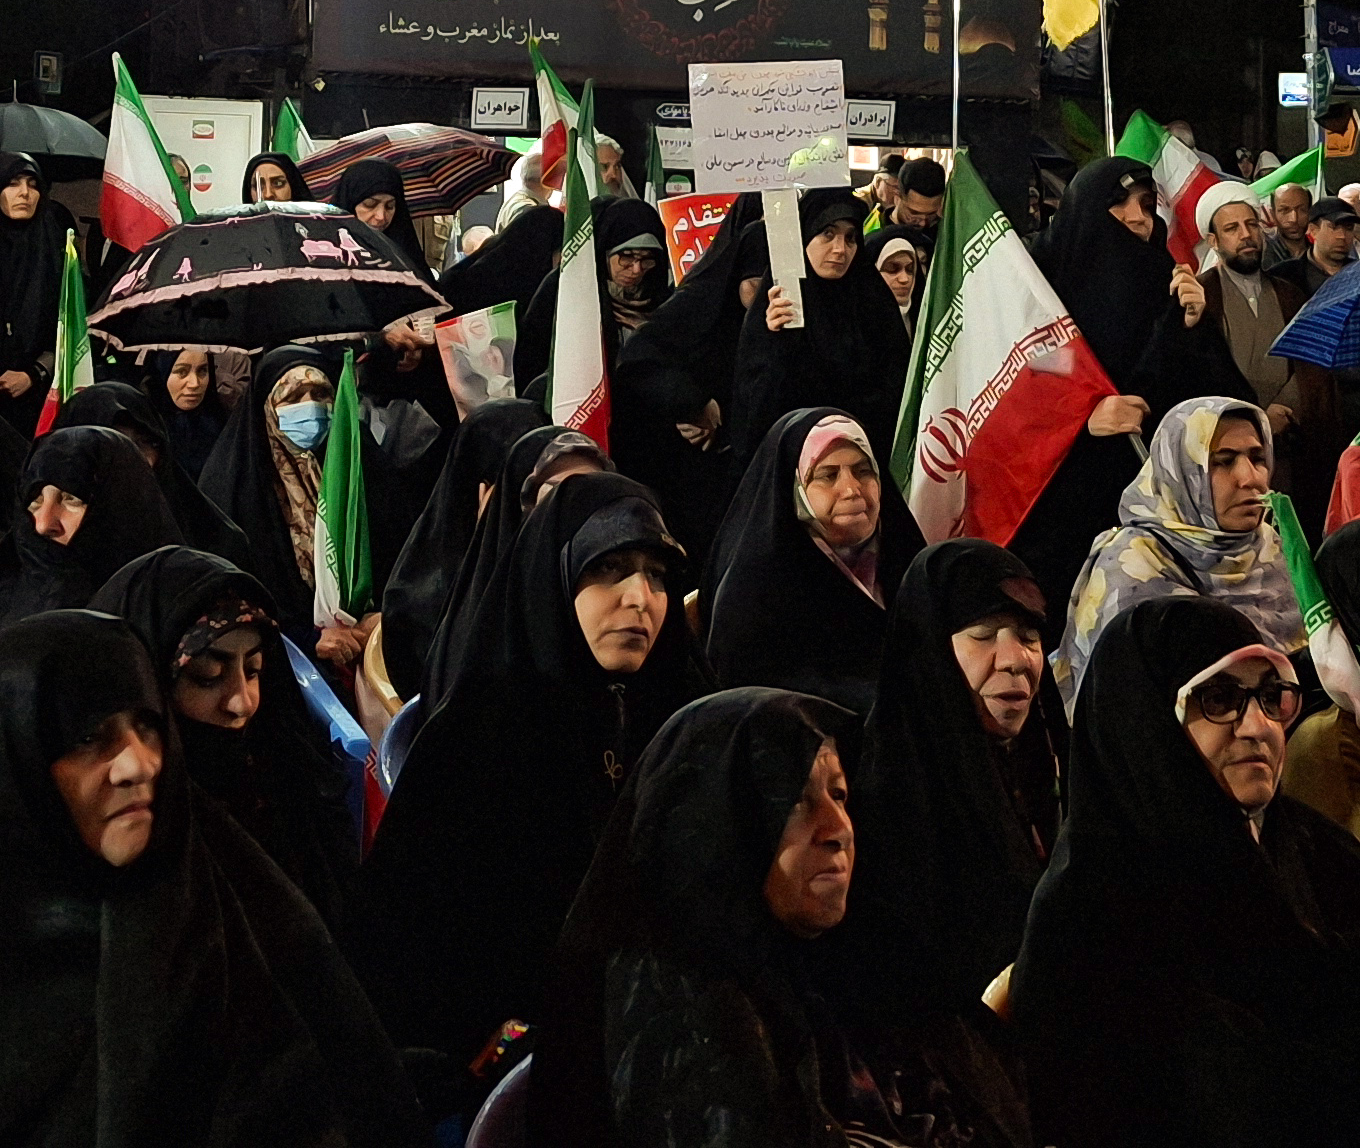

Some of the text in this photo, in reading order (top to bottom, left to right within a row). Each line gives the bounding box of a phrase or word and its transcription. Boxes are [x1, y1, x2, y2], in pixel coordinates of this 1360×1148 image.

[378, 10, 421, 34] عشاء
[488, 15, 516, 45] نماز
[421, 25, 435, 41] و
[436, 22, 488, 44] مغرب
[477, 102, 521, 116] خواهران
[849, 112, 887, 128] برادران
